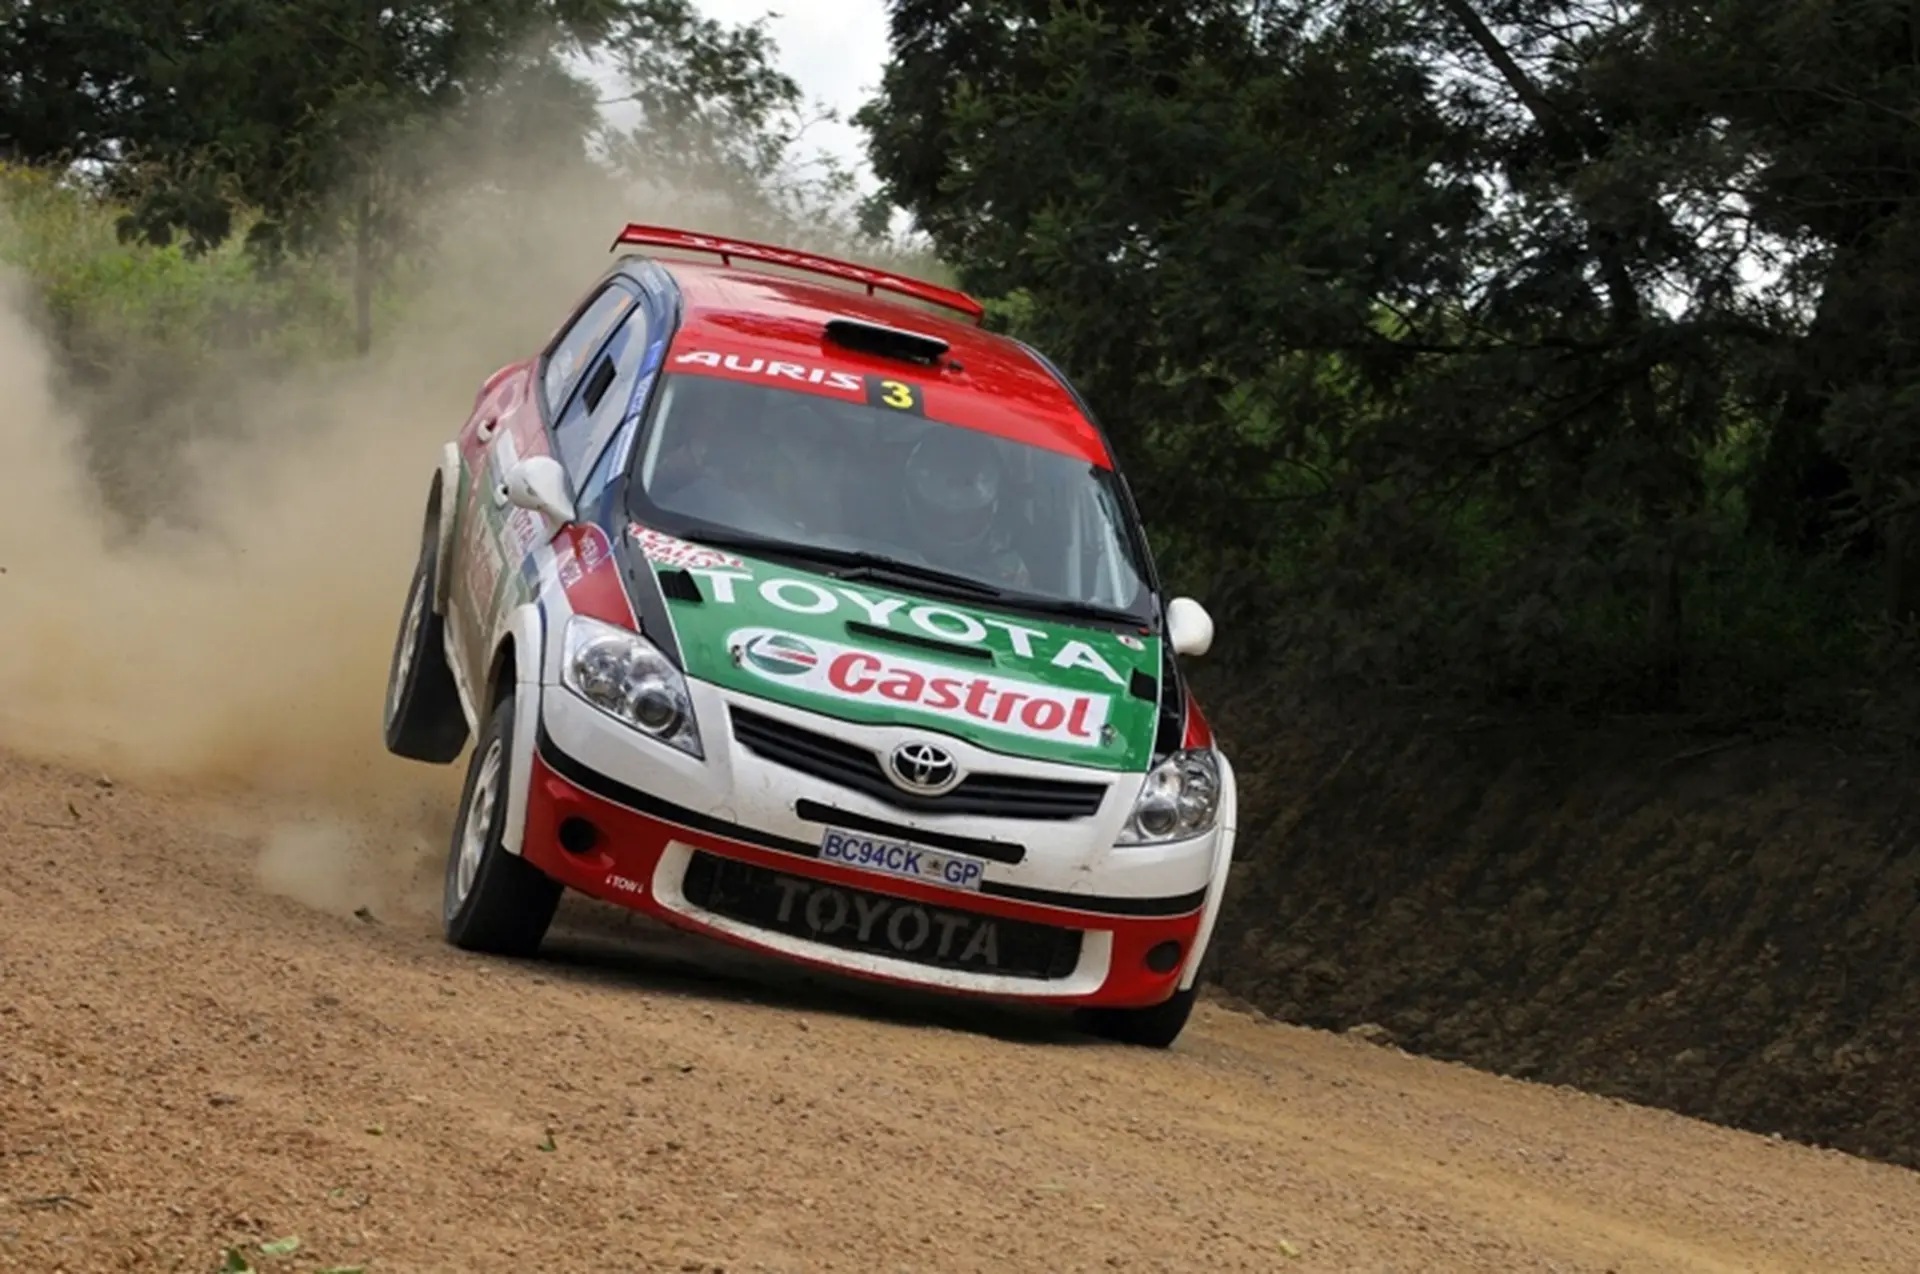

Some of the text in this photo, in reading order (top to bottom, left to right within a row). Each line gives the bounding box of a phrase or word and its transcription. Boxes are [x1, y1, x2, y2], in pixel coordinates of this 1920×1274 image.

[675, 350, 863, 391] AURIS
[881, 380, 914, 409] 3
[687, 567, 1128, 686] TOYOTA
[827, 650, 1092, 739] Castrol
[824, 834, 979, 885] BC94CK GP
[773, 876, 1000, 966] TOYOTA
